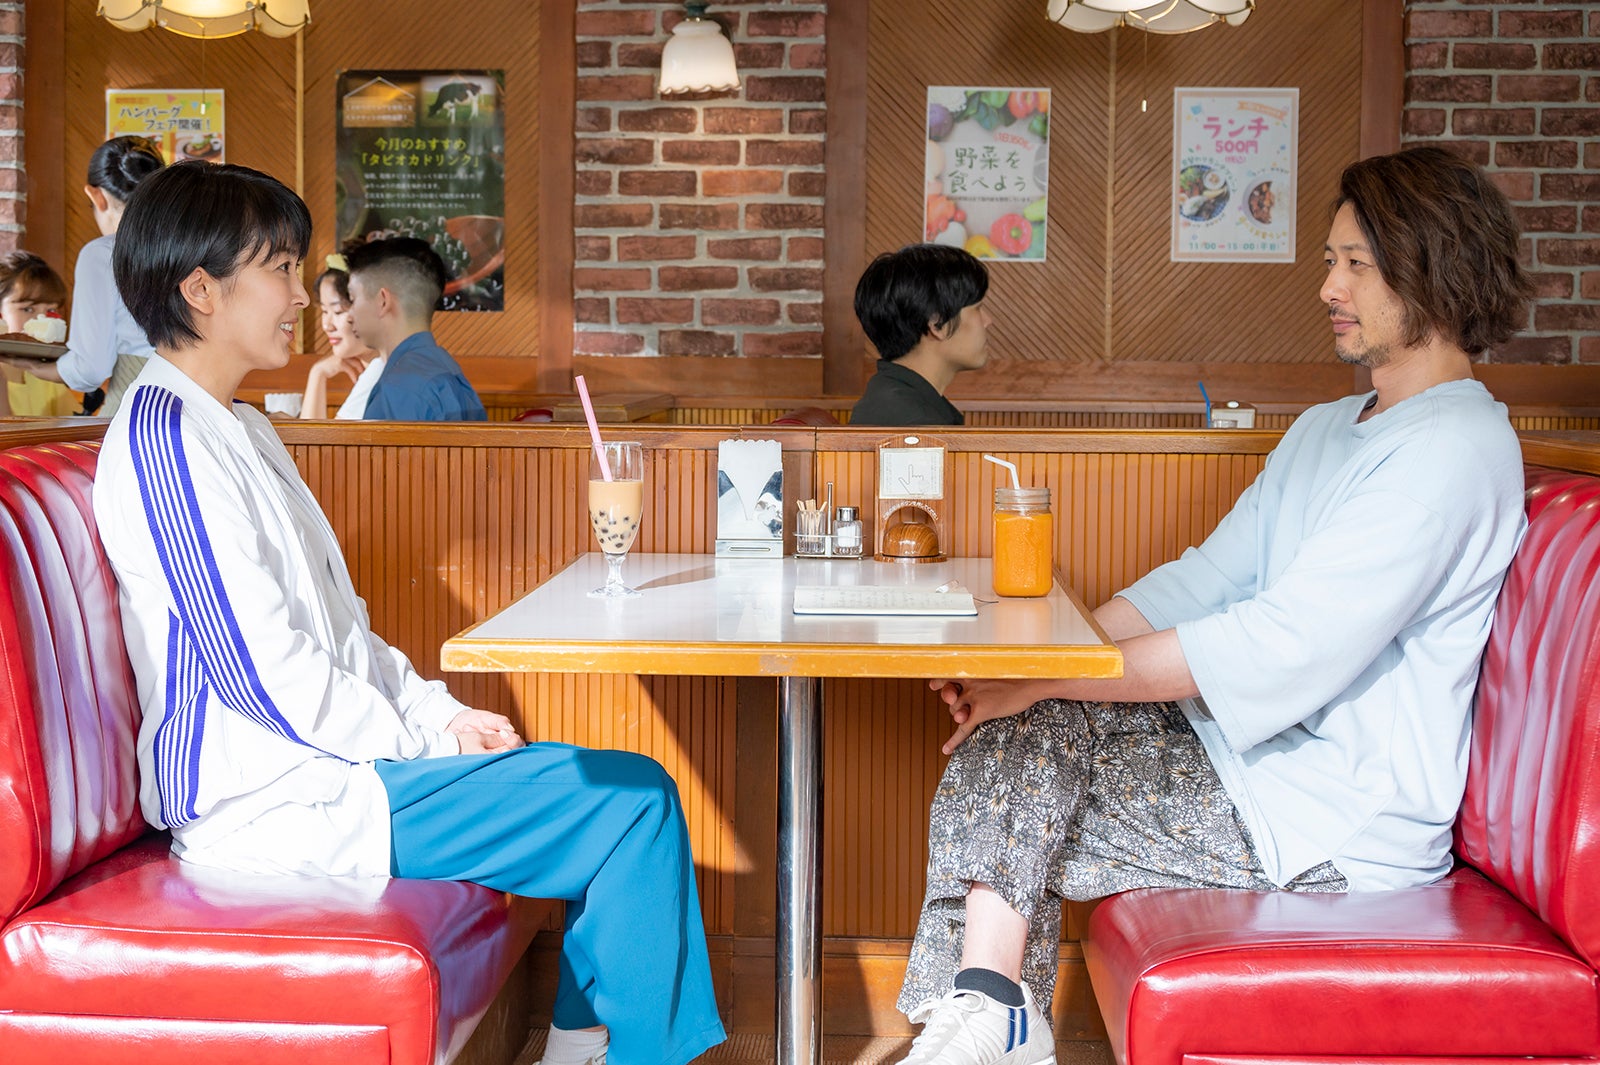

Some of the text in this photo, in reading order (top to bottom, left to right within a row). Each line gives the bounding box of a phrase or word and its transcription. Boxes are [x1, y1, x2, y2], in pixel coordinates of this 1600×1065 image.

[120, 105, 182, 118] ハンバーグ
[1203, 116, 1269, 139] ランチ
[374, 137, 467, 151] 今月のおすすめ
[1215, 140, 1258, 154] 500円
[955, 145, 1021, 170] 野菜を
[948, 169, 1026, 194] 食べよう
